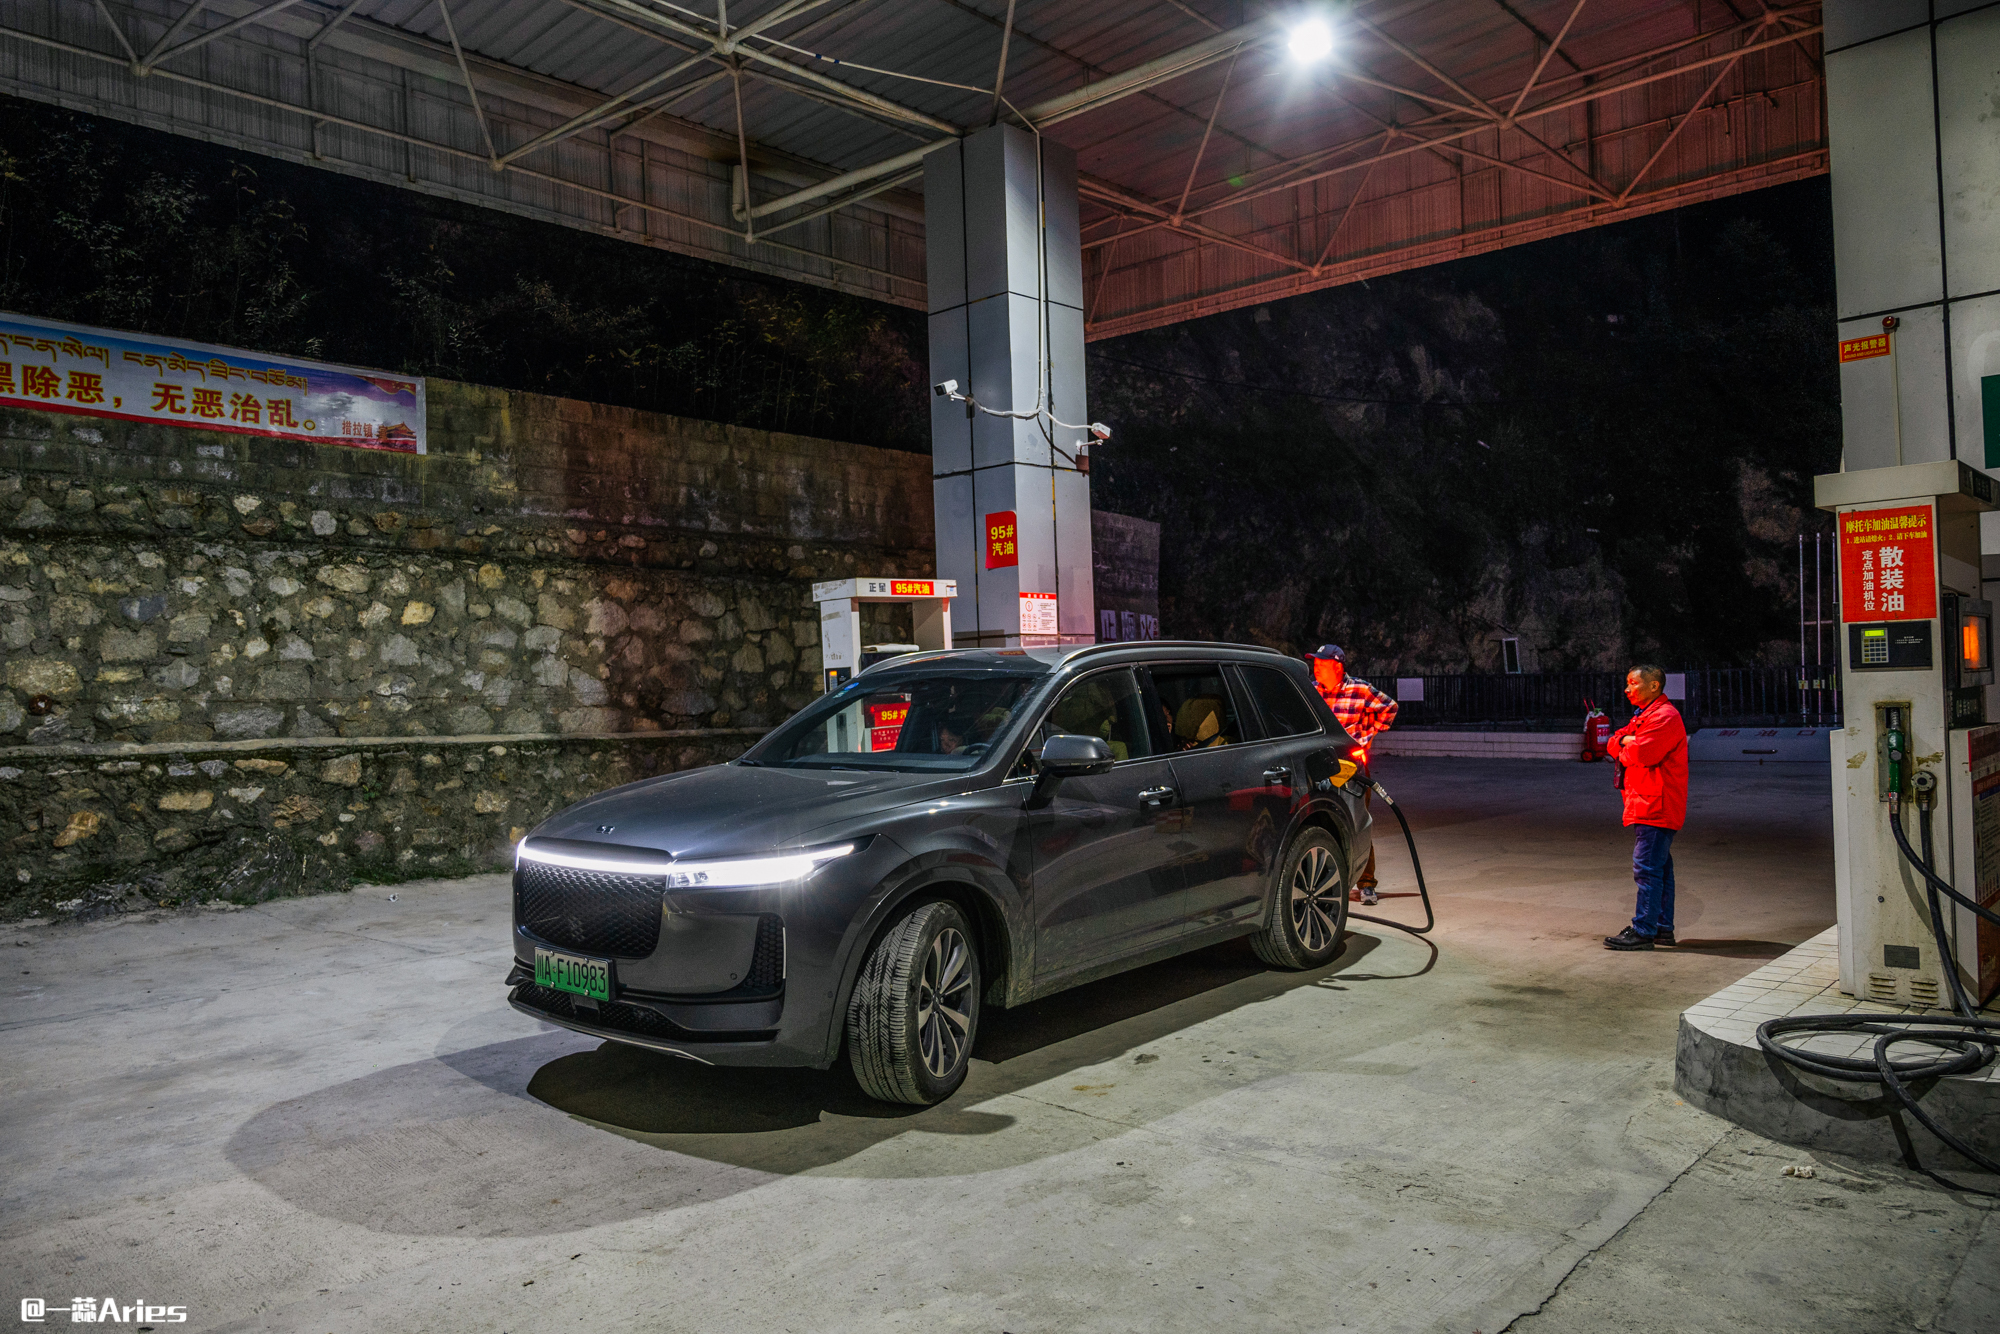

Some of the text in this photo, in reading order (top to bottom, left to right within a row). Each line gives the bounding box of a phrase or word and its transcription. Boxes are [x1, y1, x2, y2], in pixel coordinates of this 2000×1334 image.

[1844, 337, 1886, 354] 声光报警器
[990, 524, 1014, 540] 95#
[1846, 514, 1926, 534] 摩托车加油温馨提示
[992, 540, 1014, 557] 汽油
[1862, 549, 1875, 611] 定点加油机位
[1879, 546, 1905, 612] 散装油
[895, 583, 930, 594] 95#汽油
